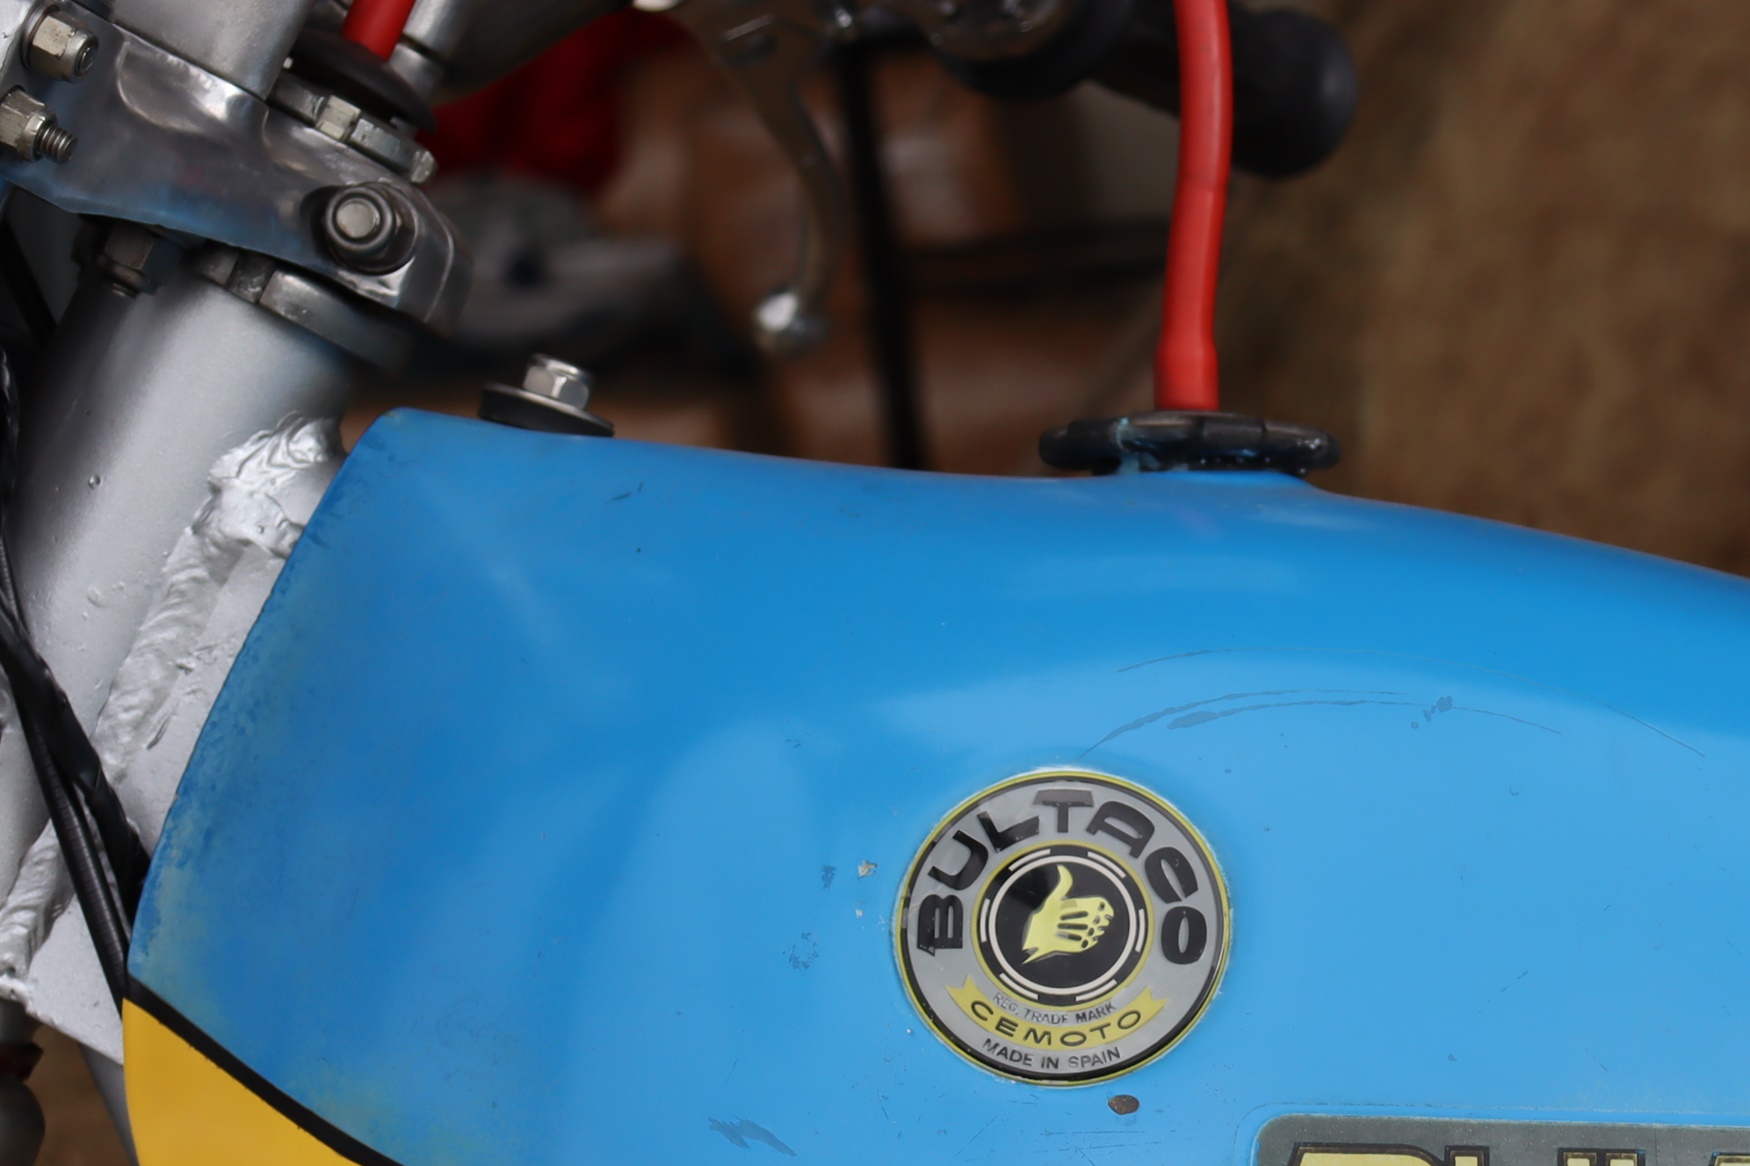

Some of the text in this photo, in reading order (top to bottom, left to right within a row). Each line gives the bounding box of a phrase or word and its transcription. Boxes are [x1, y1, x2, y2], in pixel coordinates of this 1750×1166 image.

[917, 788, 1208, 965] BULTACO
[970, 1000, 1142, 1047] CEMOTO
[992, 992, 1117, 1025] REG. TRADE MARK
[982, 1038, 1121, 1070] MADE IN SPAIN
